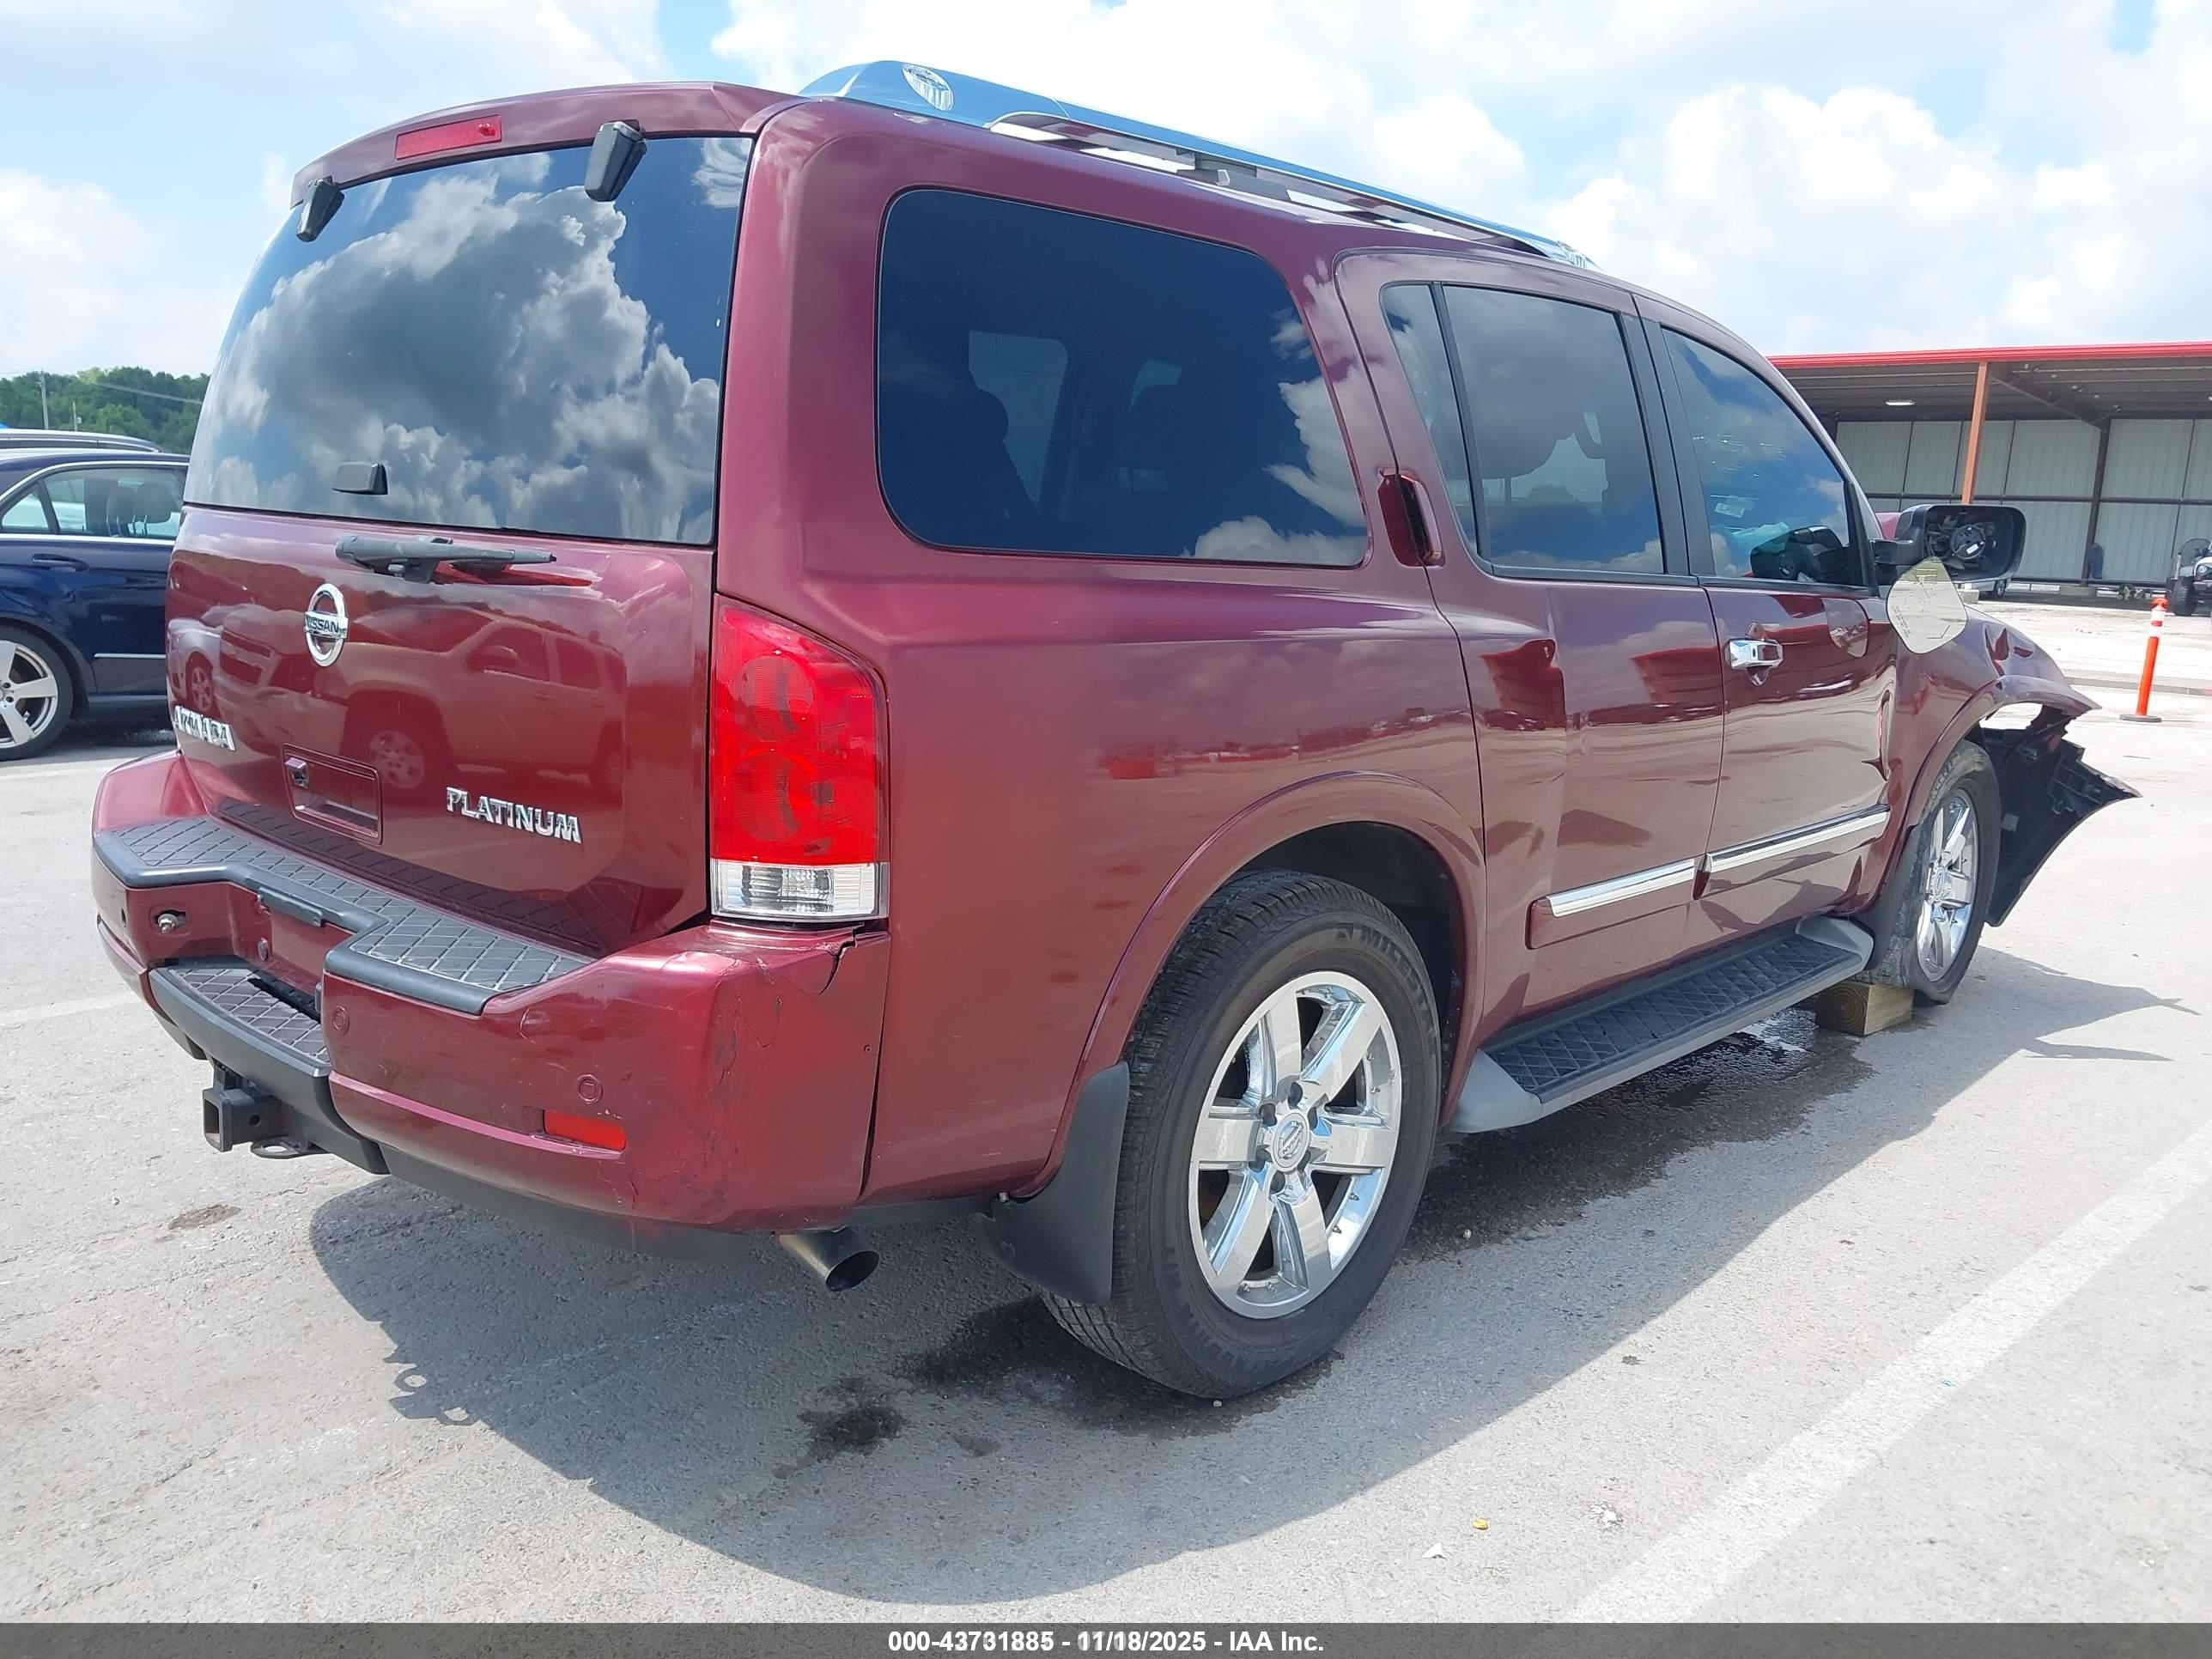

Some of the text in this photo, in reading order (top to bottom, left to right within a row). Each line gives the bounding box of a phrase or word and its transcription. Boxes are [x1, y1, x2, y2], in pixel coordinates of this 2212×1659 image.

[307, 615, 339, 634] NISSAN
[174, 705, 235, 751] ARMADA
[446, 787, 582, 844] PLATINUM
